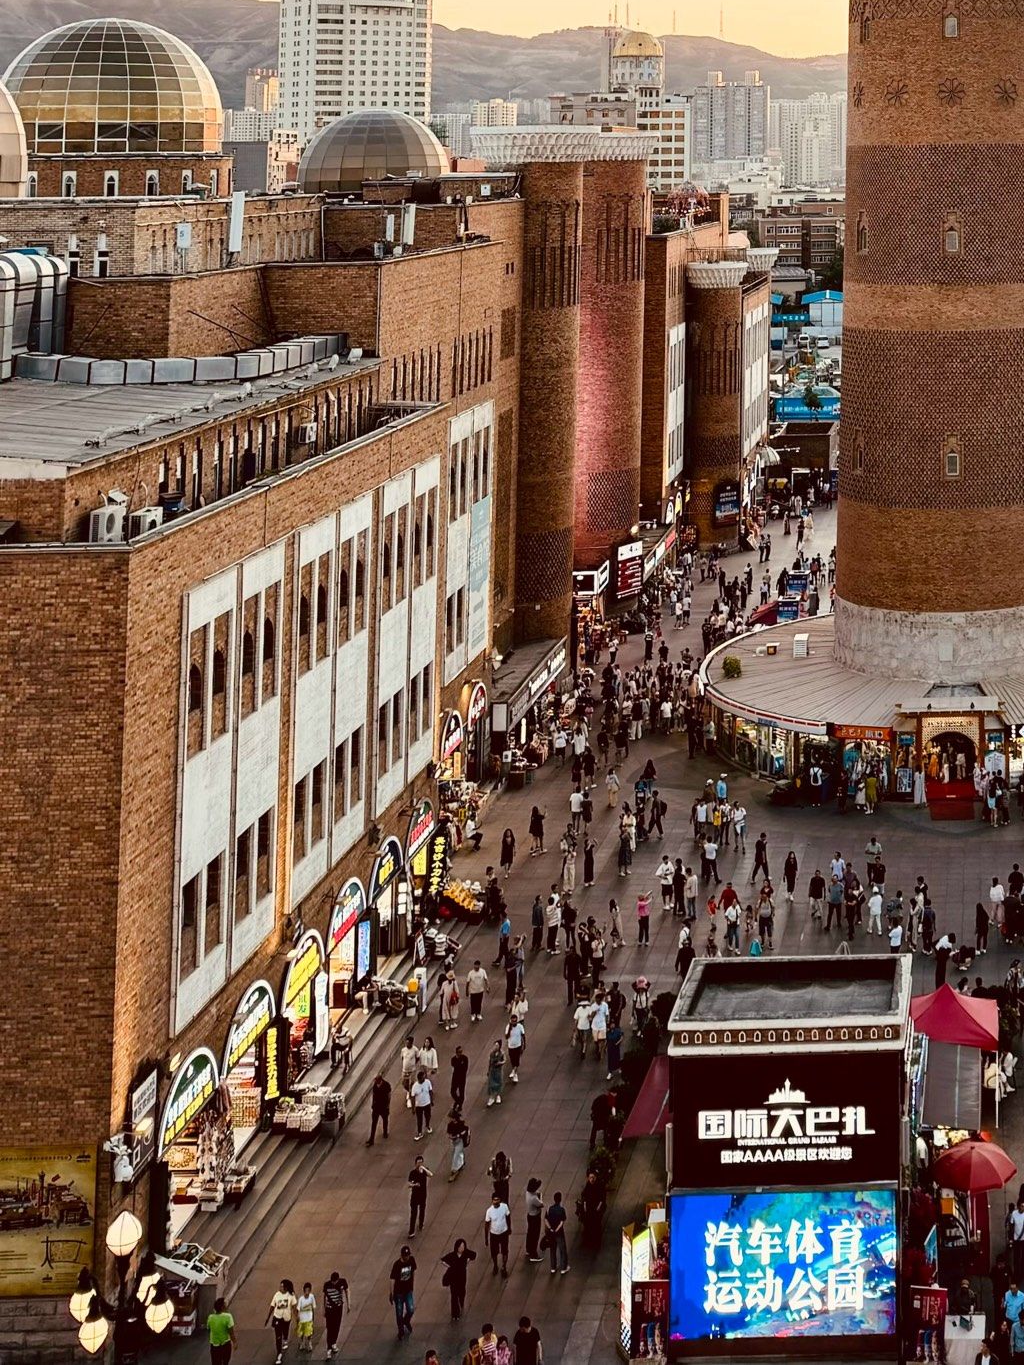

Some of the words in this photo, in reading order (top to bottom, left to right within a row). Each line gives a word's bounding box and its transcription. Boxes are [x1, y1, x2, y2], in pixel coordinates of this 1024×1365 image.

[698, 1106, 876, 1140] 国际大巴扎
[737, 1137, 787, 1146] INTERNATIONAL
[788, 1136, 811, 1145] GRAND
[811, 1136, 837, 1144] BAZAAR
[704, 1217, 864, 1266] 汽车体育
[703, 1266, 865, 1314] 运动公园
